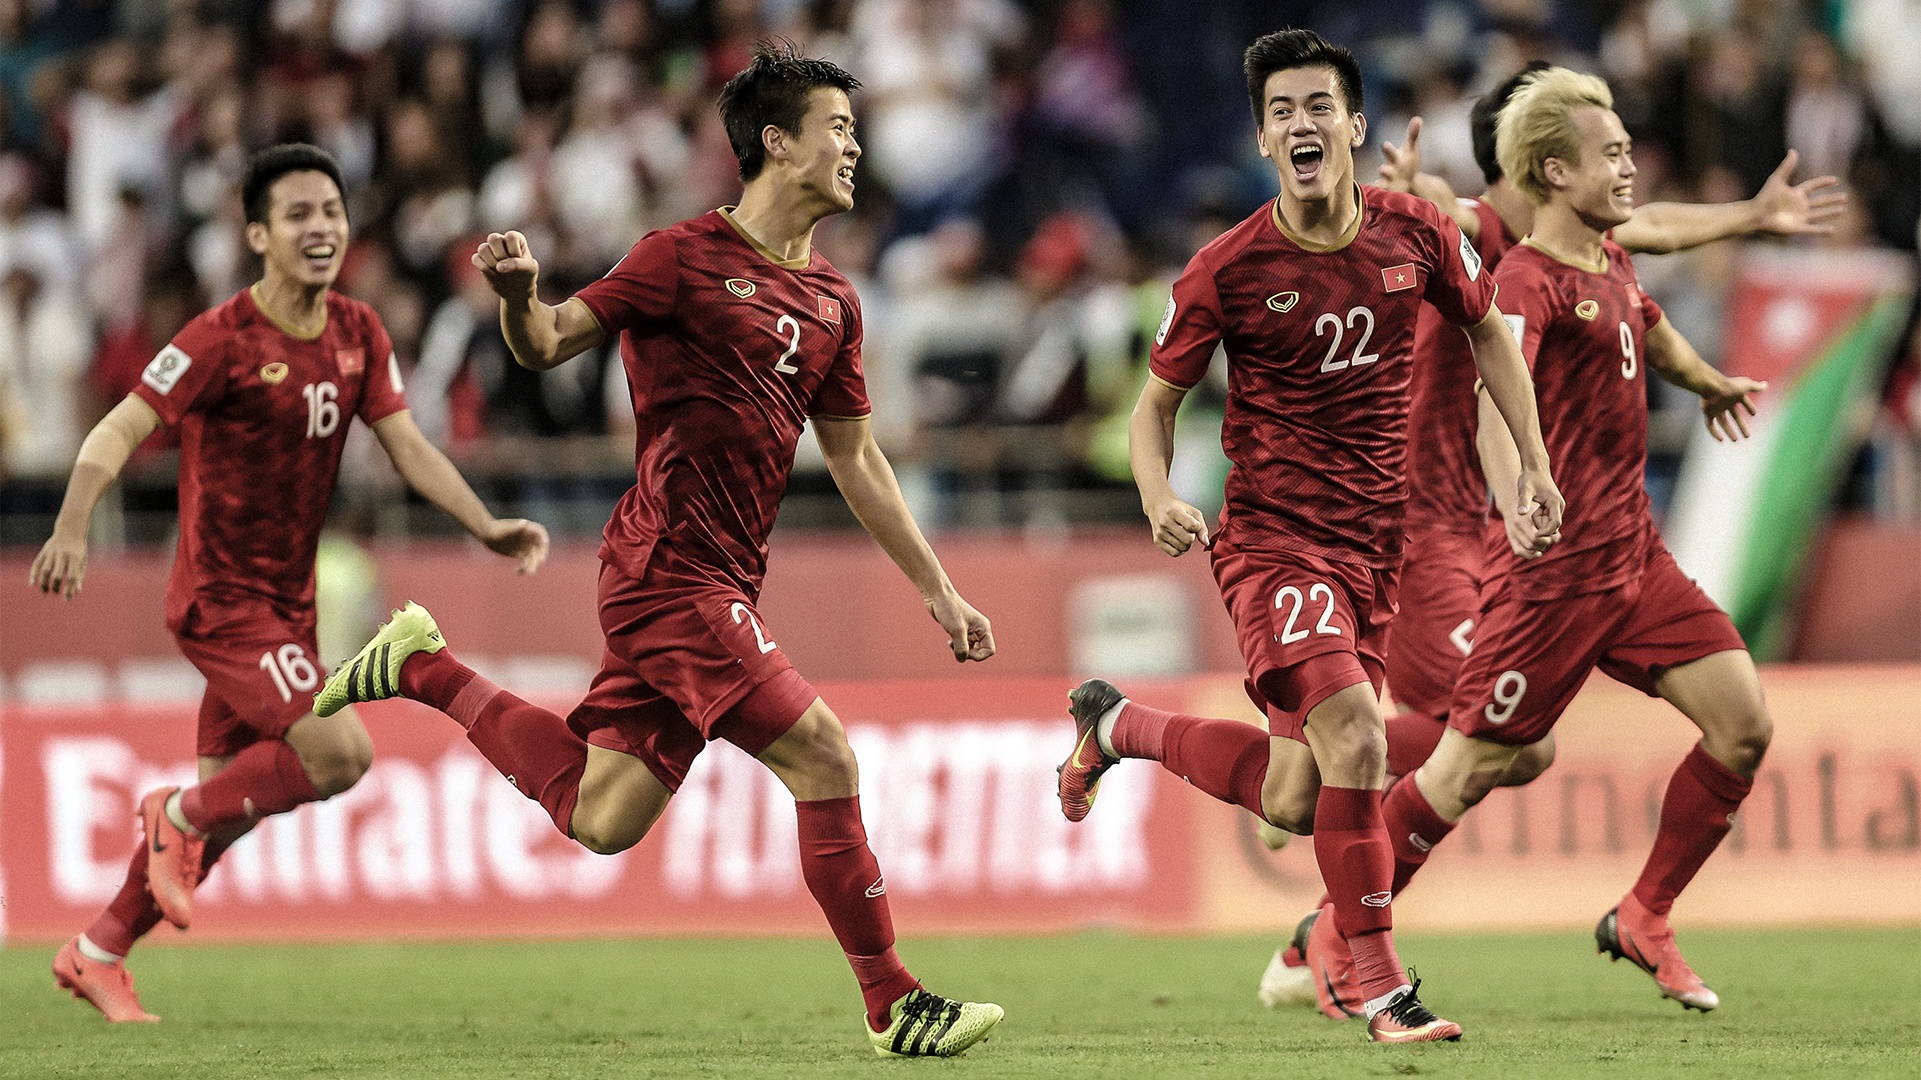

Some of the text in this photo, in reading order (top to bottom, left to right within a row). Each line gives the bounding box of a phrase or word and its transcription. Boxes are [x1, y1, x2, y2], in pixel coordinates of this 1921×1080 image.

[774, 314, 801, 375] 2
[1315, 305, 1379, 373] 22
[1618, 320, 1638, 380] 9
[302, 380, 340, 439] 16
[731, 602, 777, 654] 2
[1274, 583, 1342, 645] 22
[259, 643, 318, 704] 16
[1485, 670, 1528, 724] 9
